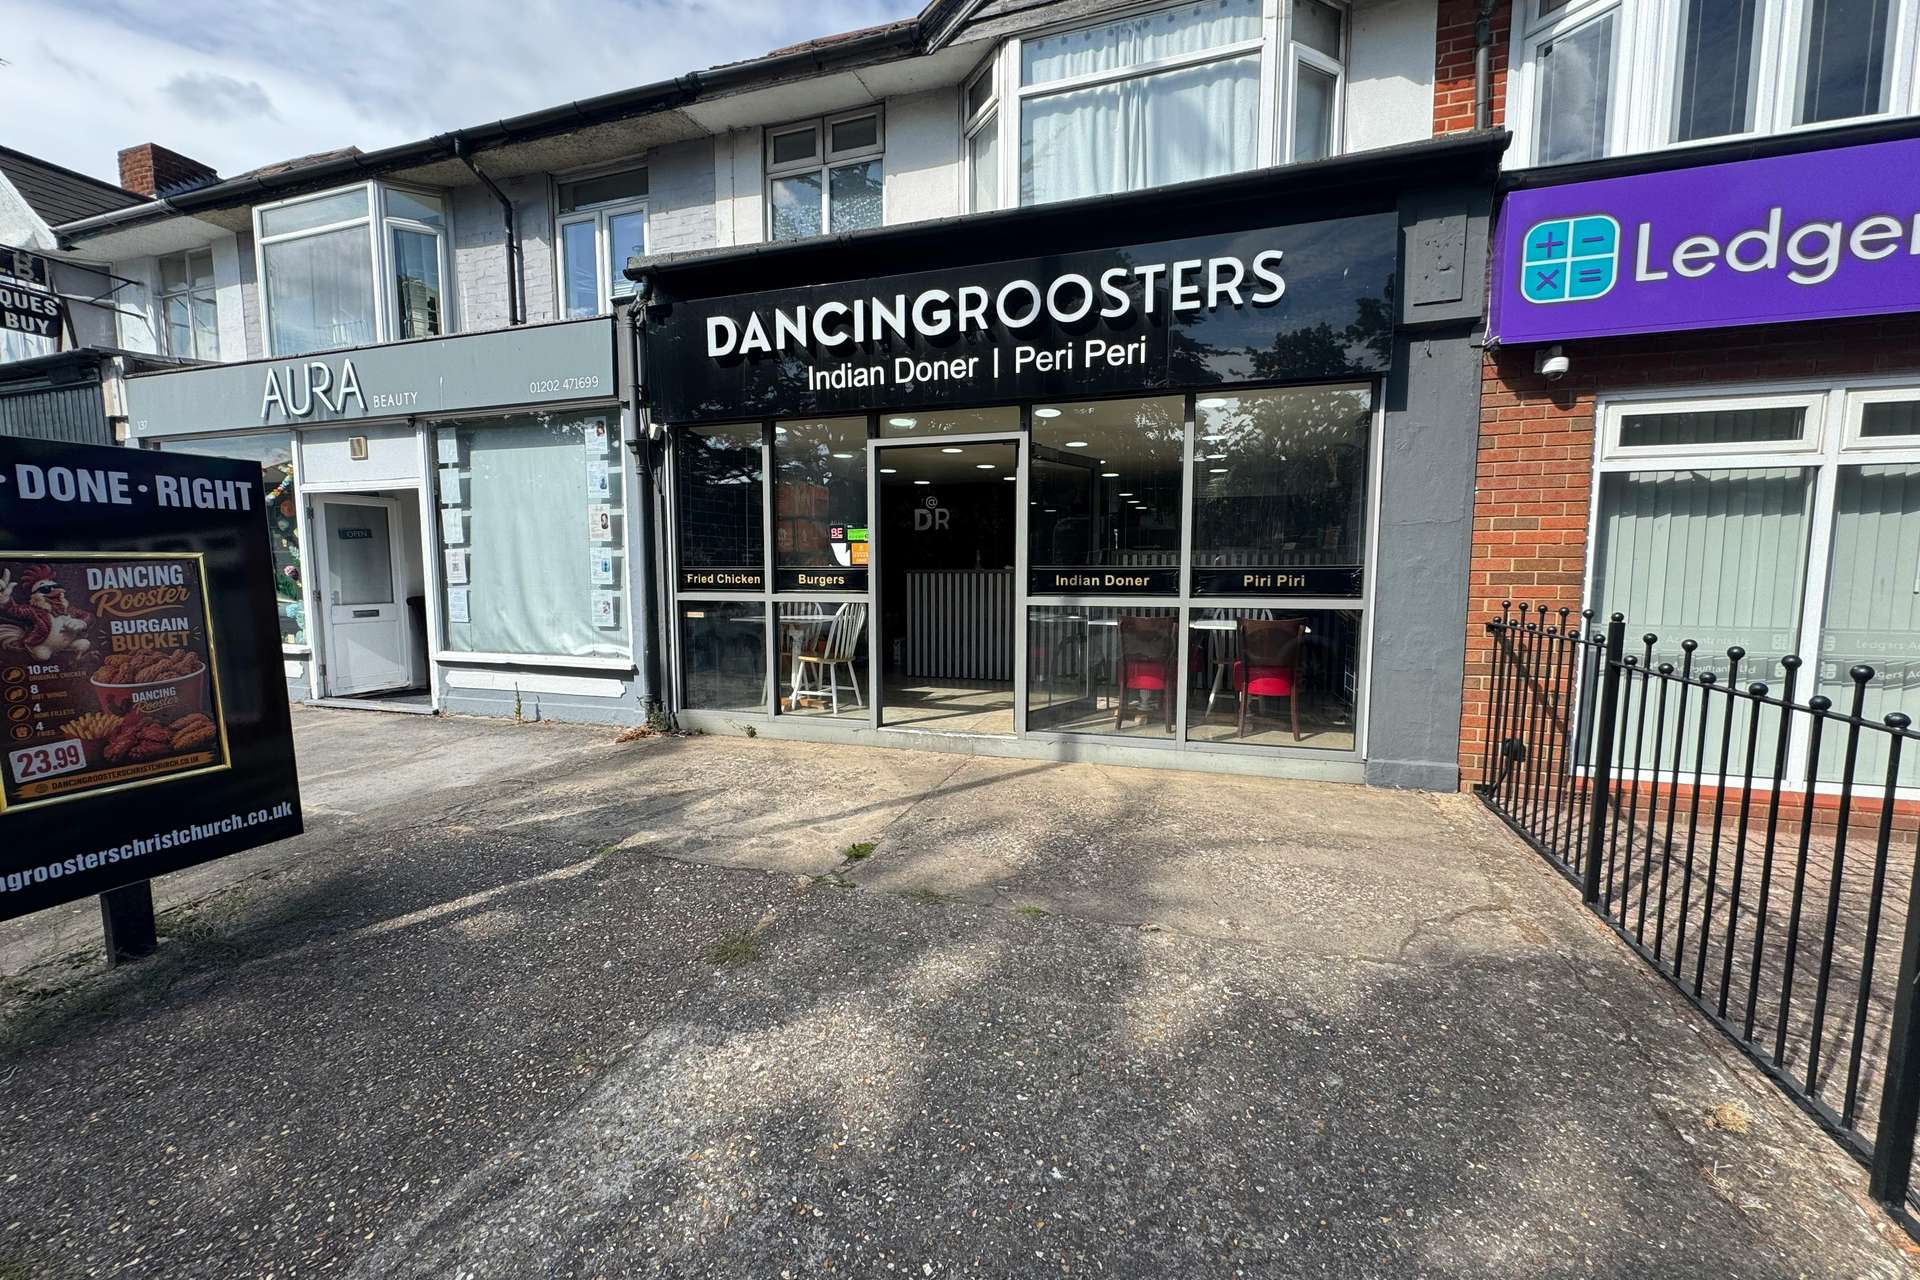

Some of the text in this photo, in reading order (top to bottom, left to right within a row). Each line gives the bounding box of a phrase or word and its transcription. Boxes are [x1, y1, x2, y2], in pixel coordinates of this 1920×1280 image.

[706, 250, 1286, 358] DANCINGROOSTERS
[5, 311, 49, 334] BUY
[808, 362, 884, 391] Indian
[895, 357, 979, 384] Doner
[1015, 342, 1073, 374] Peri
[1085, 335, 1146, 368] Peri
[260, 358, 418, 418] AURA BEAUTY
[529, 376, 599, 394] 01202 471699
[15, 464, 252, 511] DONE RIGHT
[913, 508, 950, 531] DR
[86, 564, 184, 591] DANCING
[687, 573, 761, 585] Fried Chicken
[798, 574, 845, 587] Burgers
[1055, 574, 1150, 587] Indian Doner
[1243, 574, 1305, 587] Piri Piri
[89, 584, 190, 616] Rooster
[110, 617, 189, 635] BURGAIN
[112, 630, 190, 652] BUCKET
[27, 665, 60, 675] 10 PCS
[30, 685, 39, 694] 8
[132, 686, 177, 703] DANCING
[33, 703, 41, 712] 4
[36, 721, 44, 730] 4
[17, 746, 80, 778] 23.99
